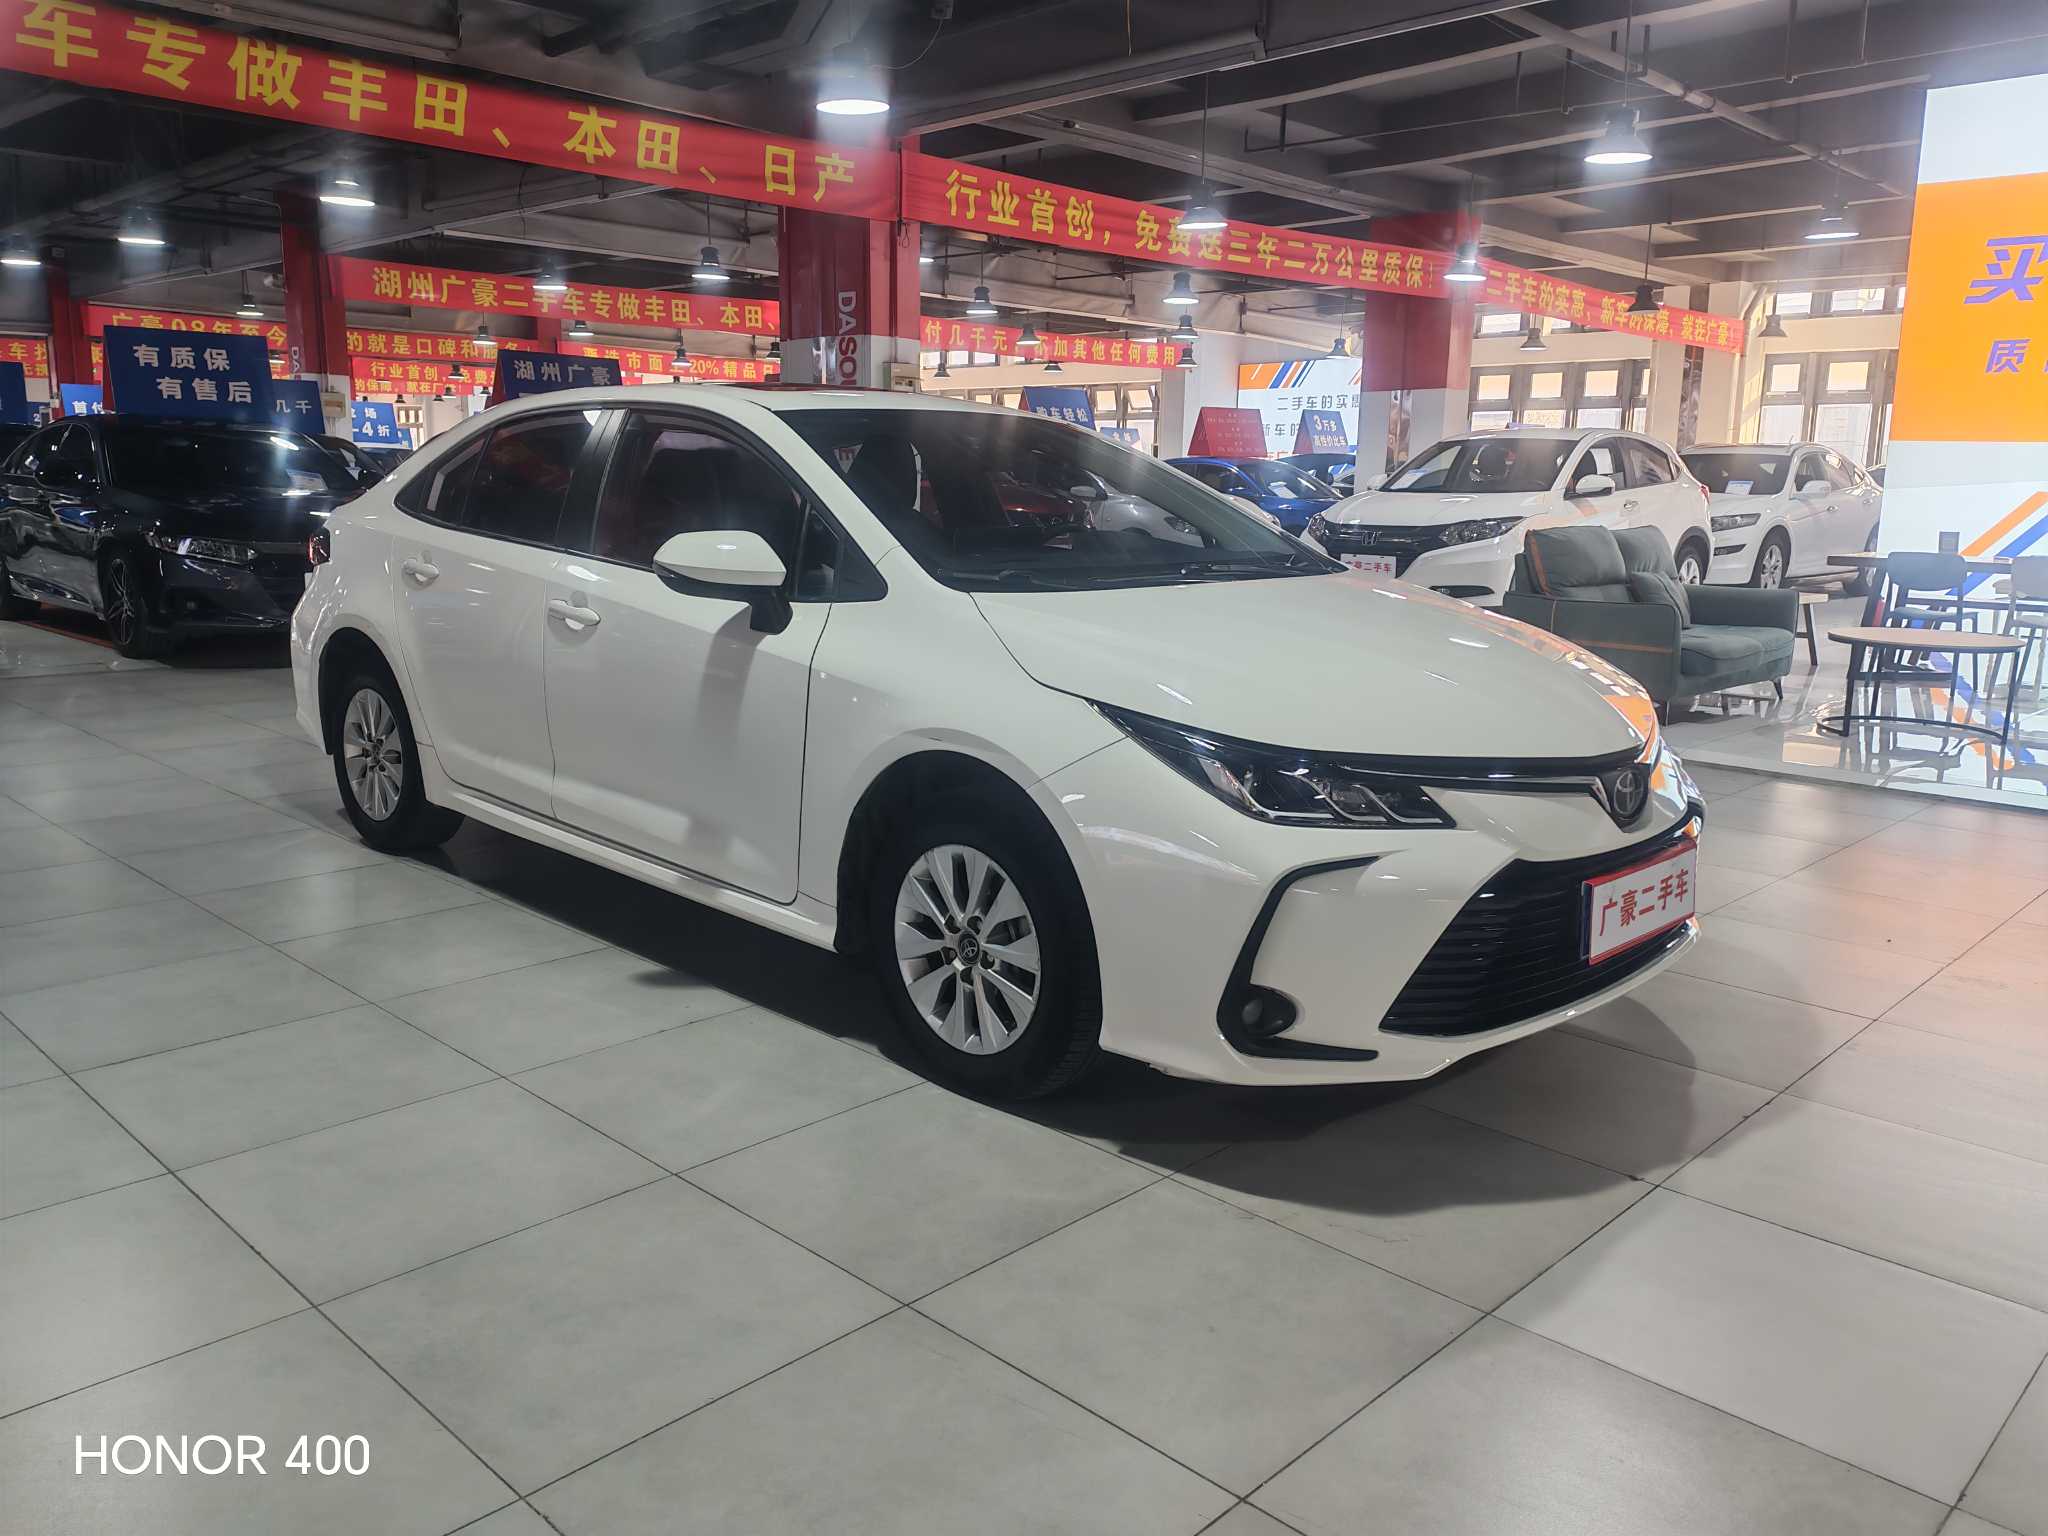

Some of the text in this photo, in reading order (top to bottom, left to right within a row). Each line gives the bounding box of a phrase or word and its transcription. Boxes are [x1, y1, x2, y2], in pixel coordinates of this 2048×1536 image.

[1963, 234, 2048, 305] 买
[133, 344, 230, 372] 有质保
[514, 359, 610, 385] 湖州广豪
[156, 376, 252, 403] 有售后
[1600, 869, 1689, 937] 广豪二手车
